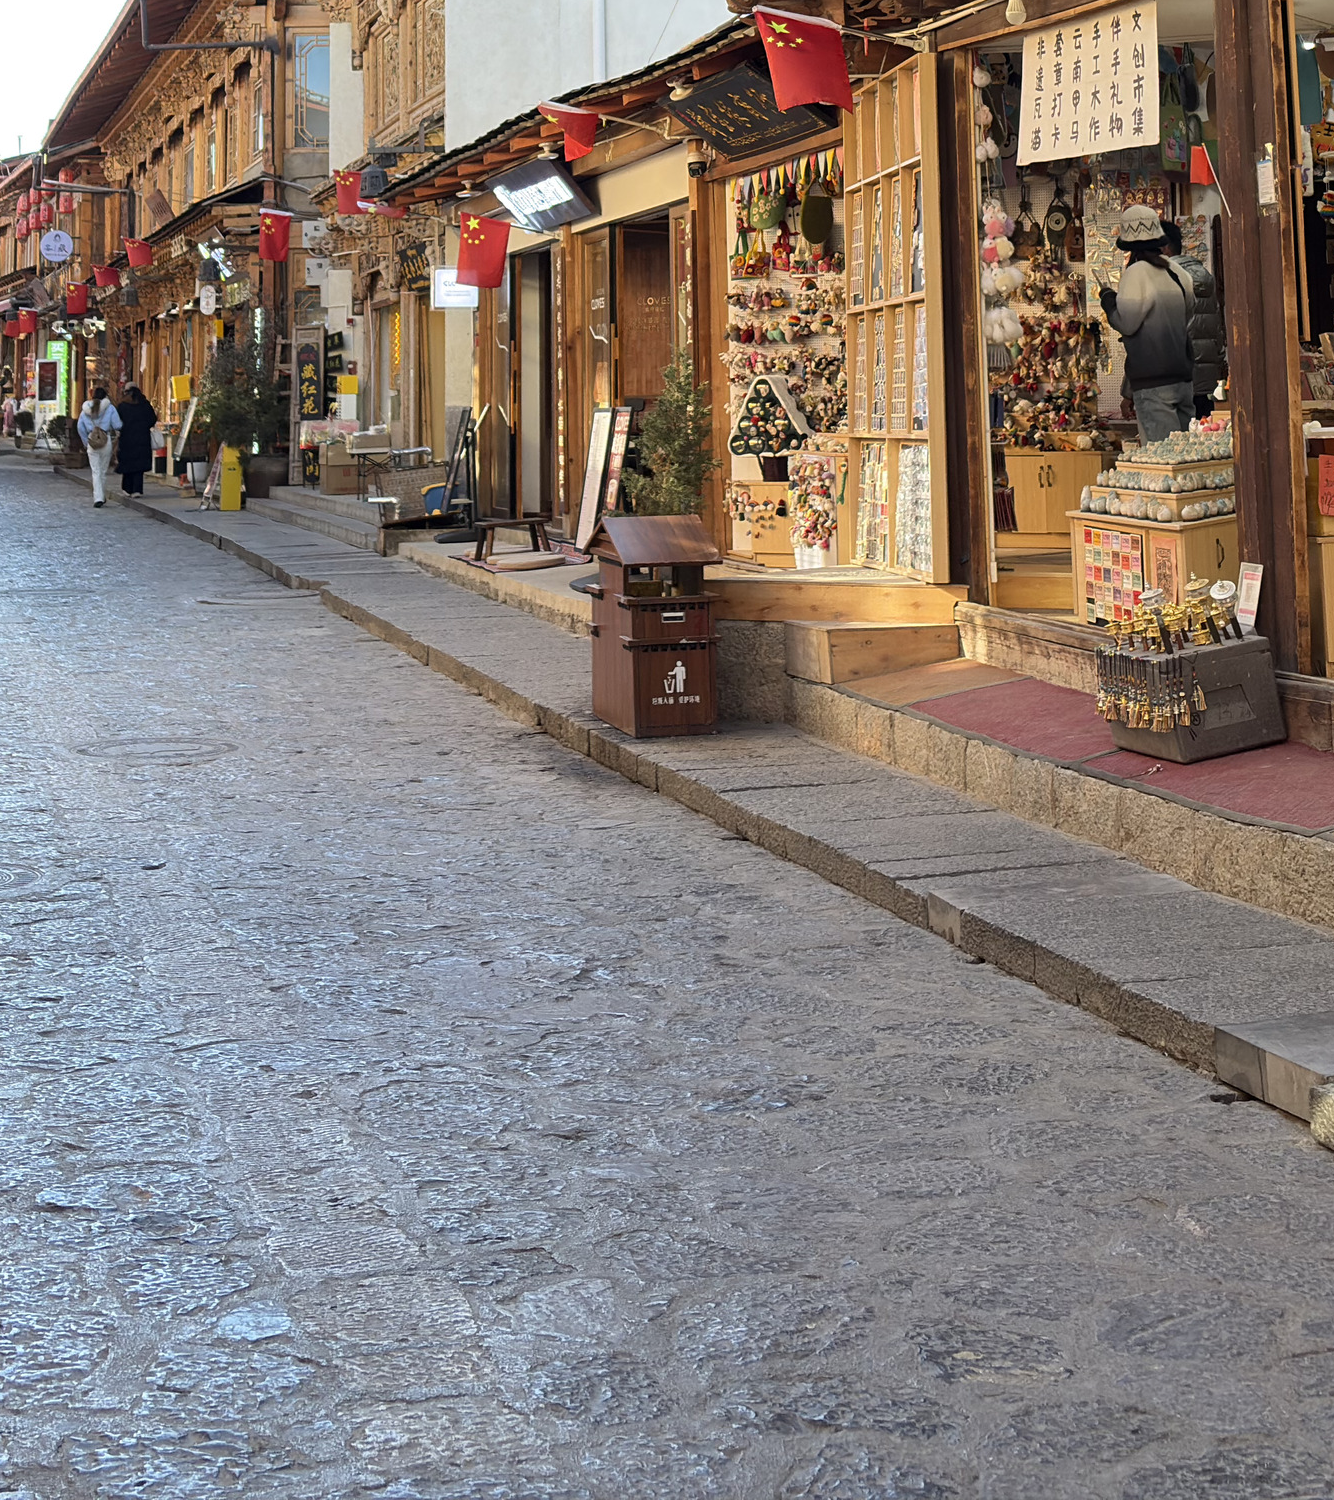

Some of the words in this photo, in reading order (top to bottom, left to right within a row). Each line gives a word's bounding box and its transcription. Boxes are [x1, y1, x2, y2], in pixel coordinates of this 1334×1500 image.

[1051, 30, 1064, 148] 套章打卡
[1070, 28, 1082, 145] 云南甲马
[1089, 20, 1101, 142] 手工木作
[1109, 14, 1124, 138] 伴手礼物
[1131, 9, 1145, 137] 文创市集
[301, 363, 318, 414] 藏红花
